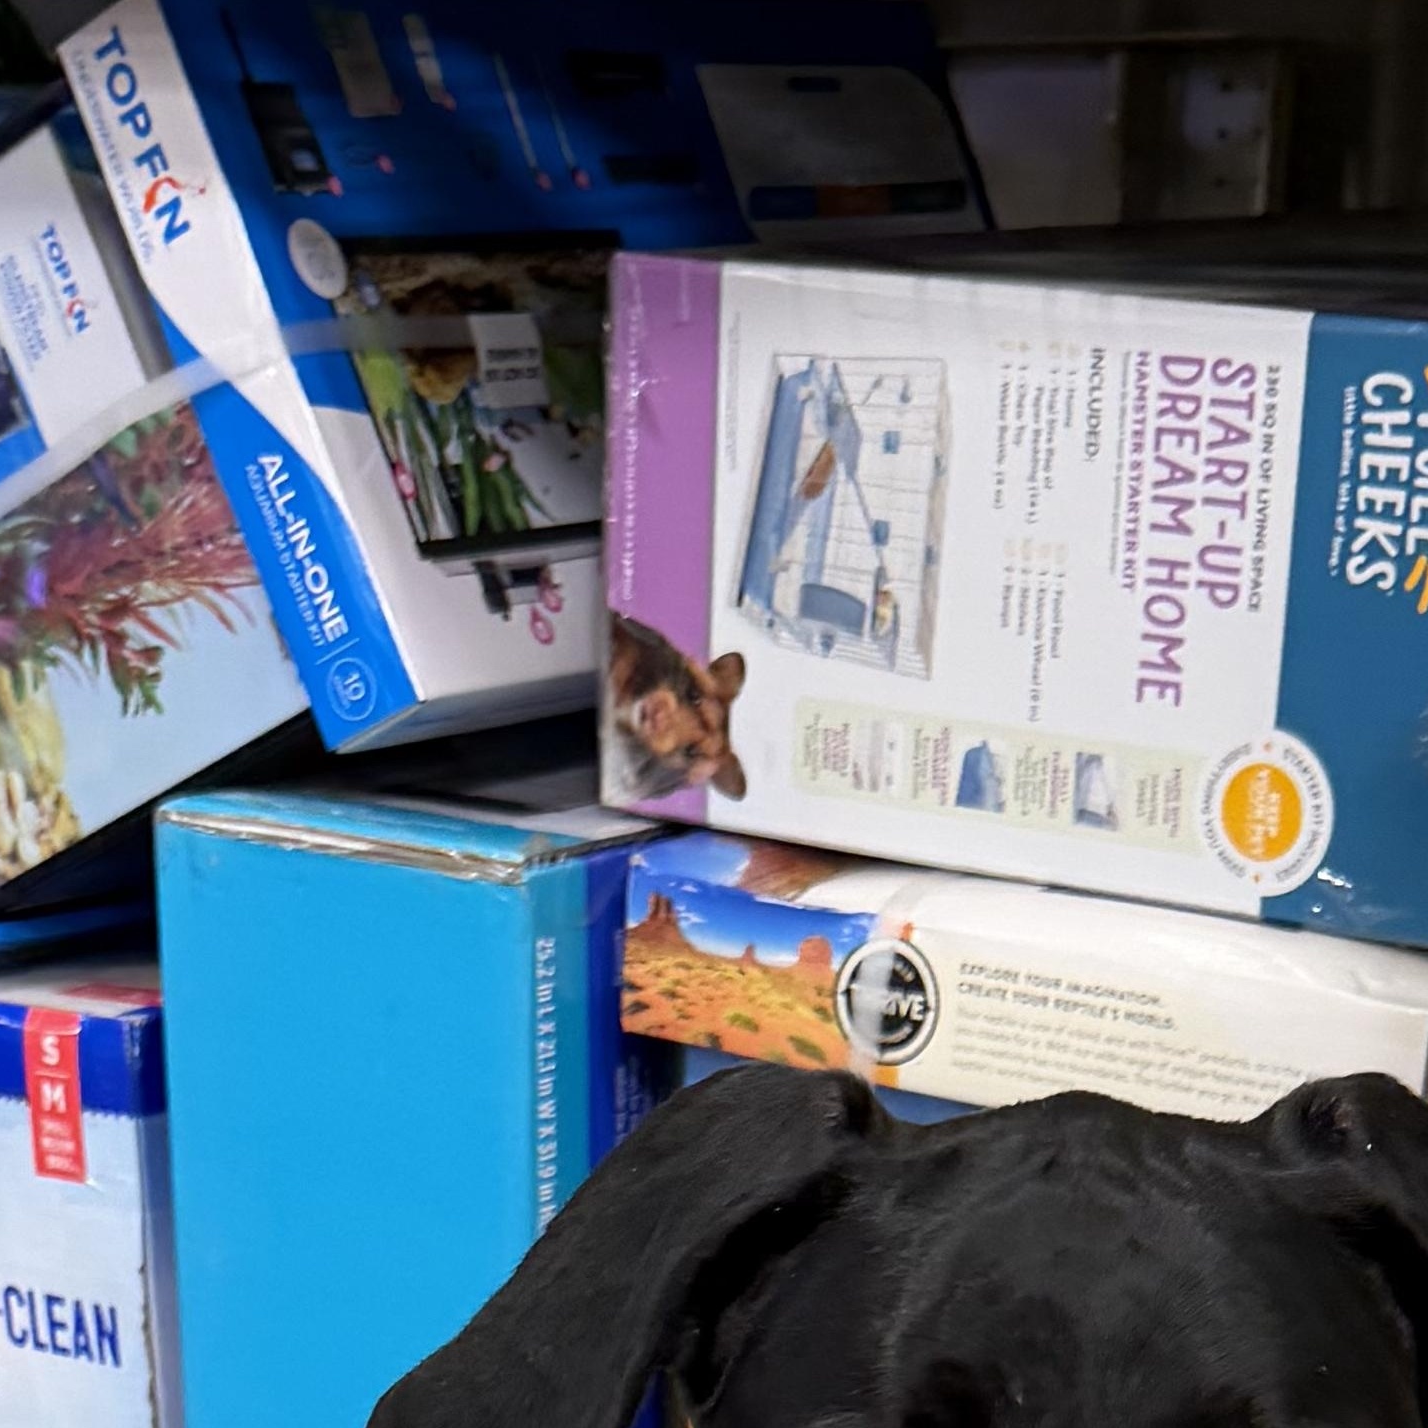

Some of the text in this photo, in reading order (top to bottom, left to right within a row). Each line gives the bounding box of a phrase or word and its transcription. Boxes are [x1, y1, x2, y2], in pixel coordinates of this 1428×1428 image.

[92, 25, 157, 144] TOP
[38, 221, 74, 283] TOP
[1081, 346, 1106, 463] INCLUDED:
[1120, 349, 1151, 595] HAMSTER STARTER KIT
[1143, 351, 1209, 539] DREAM
[1257, 457, 1274, 484] OF
[1259, 432, 1276, 455] IN
[1188, 355, 1261, 612] START-UP
[1343, 369, 1415, 590] CHEEKS
[255, 449, 351, 643] ALL-IN-ONE
[1250, 486, 1271, 552] LIVING
[1246, 554, 1266, 614] SPACE
[1134, 555, 1189, 709] HOME
[339, 668, 370, 704] 10
[40, 1035, 60, 1067] S
[39, 1082, 67, 1115] M
[537, 1098, 556, 1121] W
